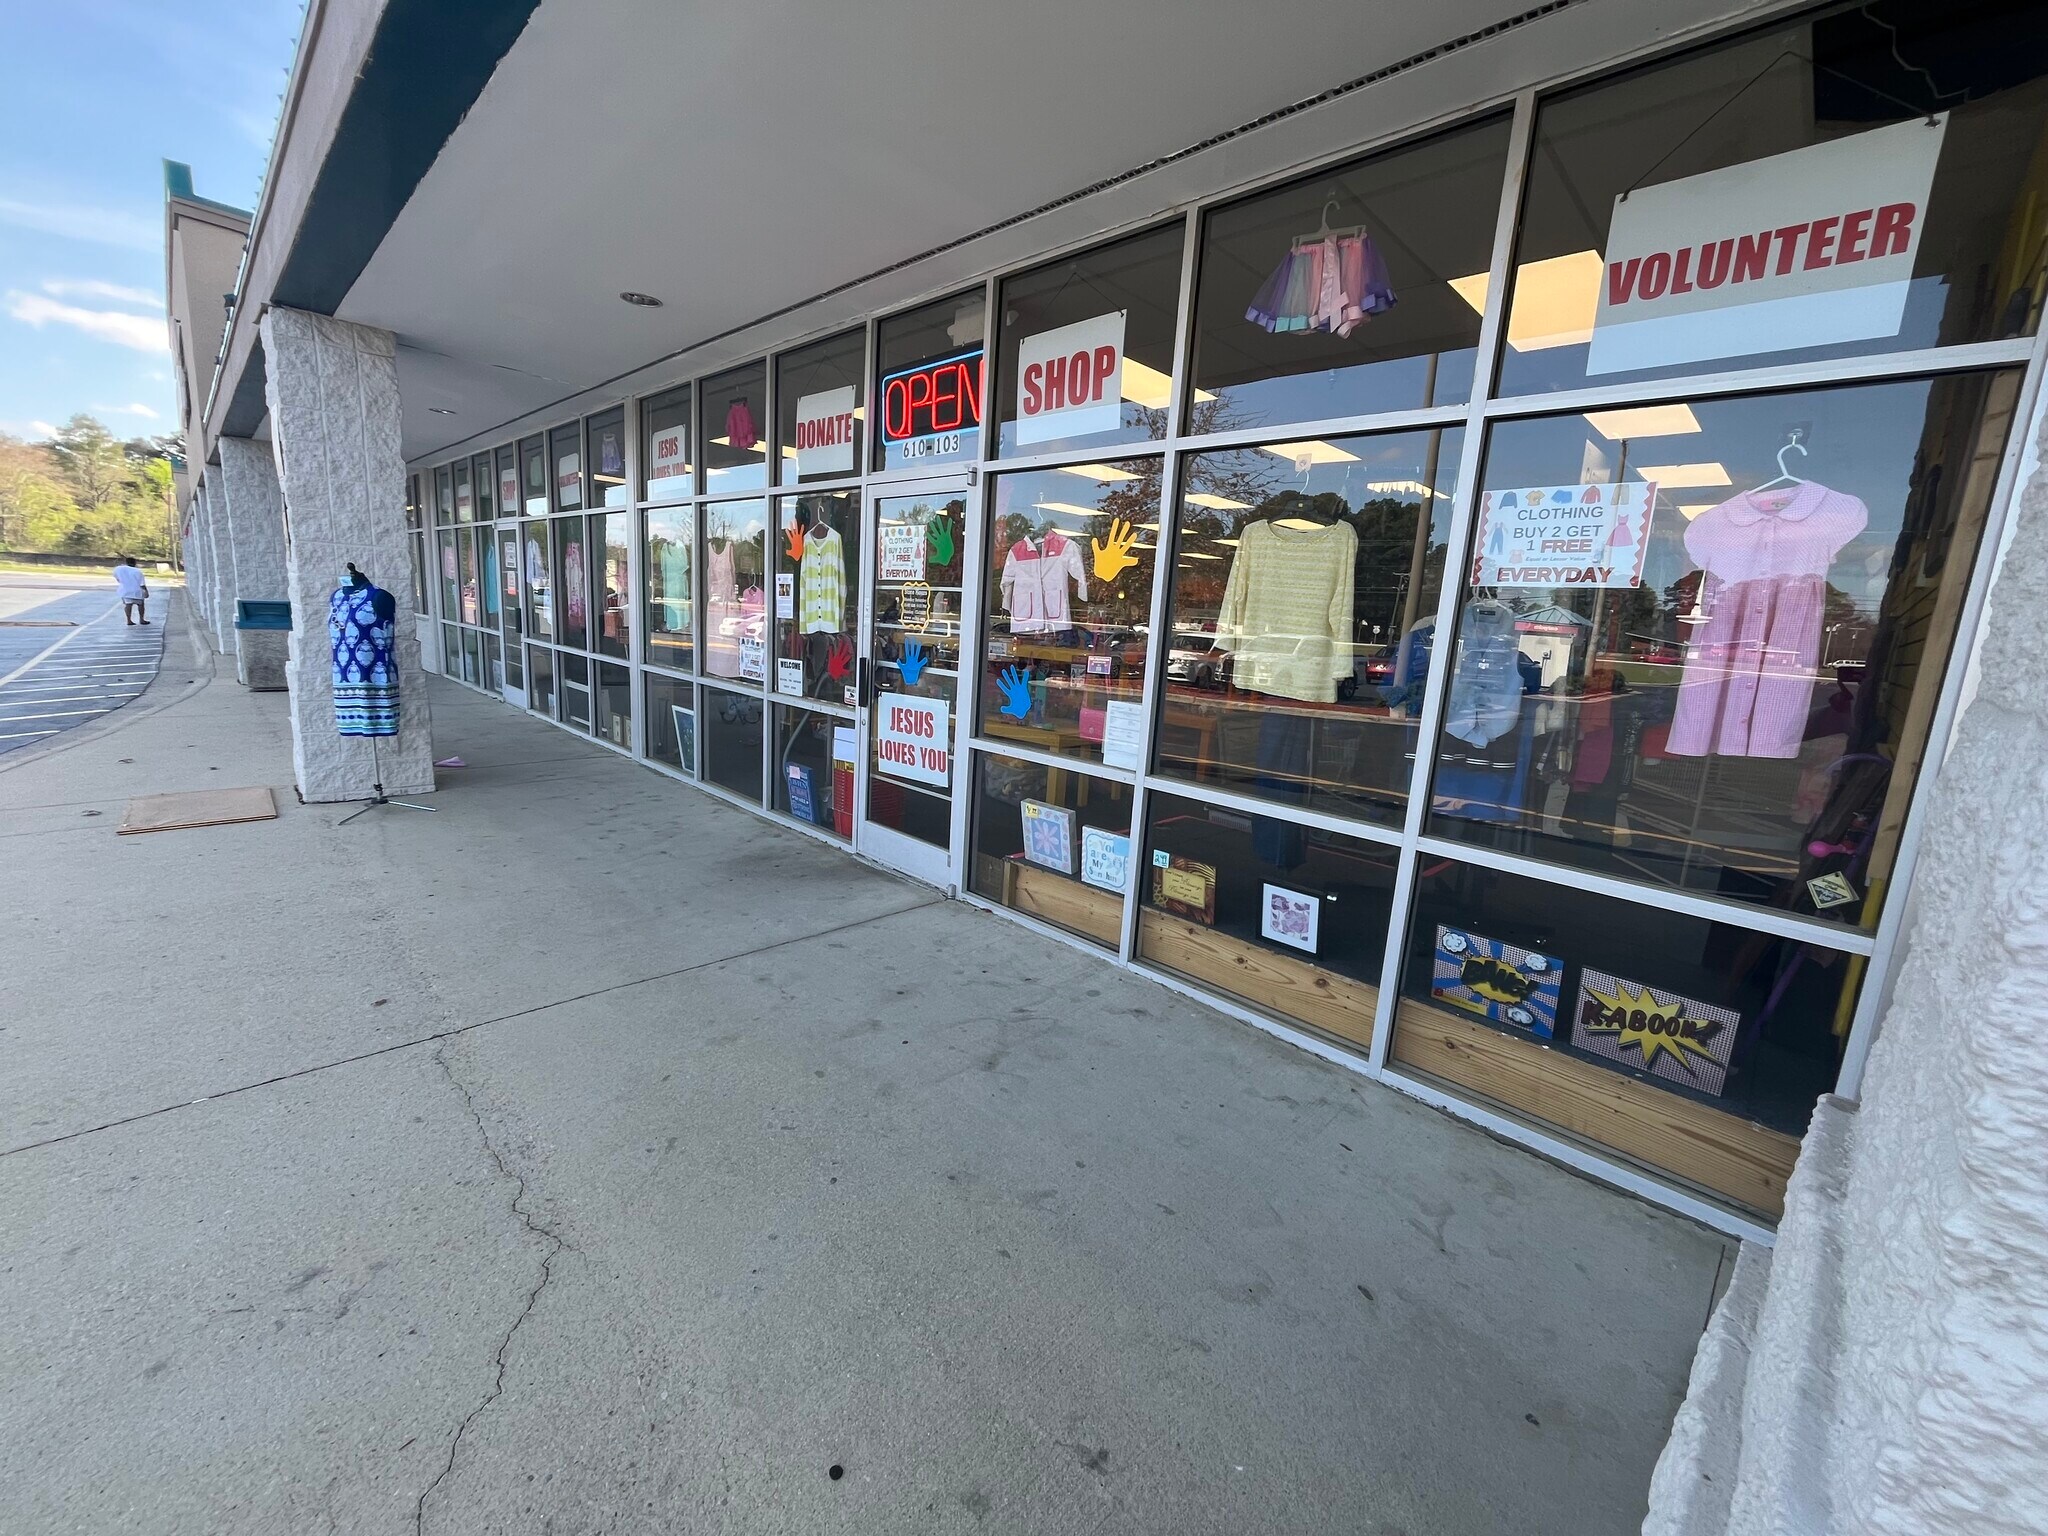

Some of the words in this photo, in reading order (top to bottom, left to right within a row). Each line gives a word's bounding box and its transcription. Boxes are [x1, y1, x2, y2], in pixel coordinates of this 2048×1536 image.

[1608, 202, 1917, 306] VOLUNTEER
[1023, 345, 1116, 416] SHOP
[885, 359, 984, 438] OPEN
[797, 412, 852, 450] DONATE
[658, 436, 678, 460] JESUS
[903, 434, 960, 458] 610-103
[1517, 506, 1604, 521] CLOTHING
[888, 537, 914, 545] CLOTHING
[1513, 526, 1548, 539] BUY
[1552, 526, 1562, 538] 2
[1566, 525, 1603, 538] GET
[903, 546, 914, 554] GET
[1526, 540, 1536, 551] 1
[1540, 538, 1594, 553] FREE
[896, 554, 911, 562] FREE
[885, 569, 918, 578] EVERYDAY
[1497, 566, 1616, 584] EVERYDAY
[780, 660, 801, 671] WELCOME
[889, 706, 934, 739] JESUS
[879, 738, 915, 767] LOVES
[919, 746, 947, 773] YOU
